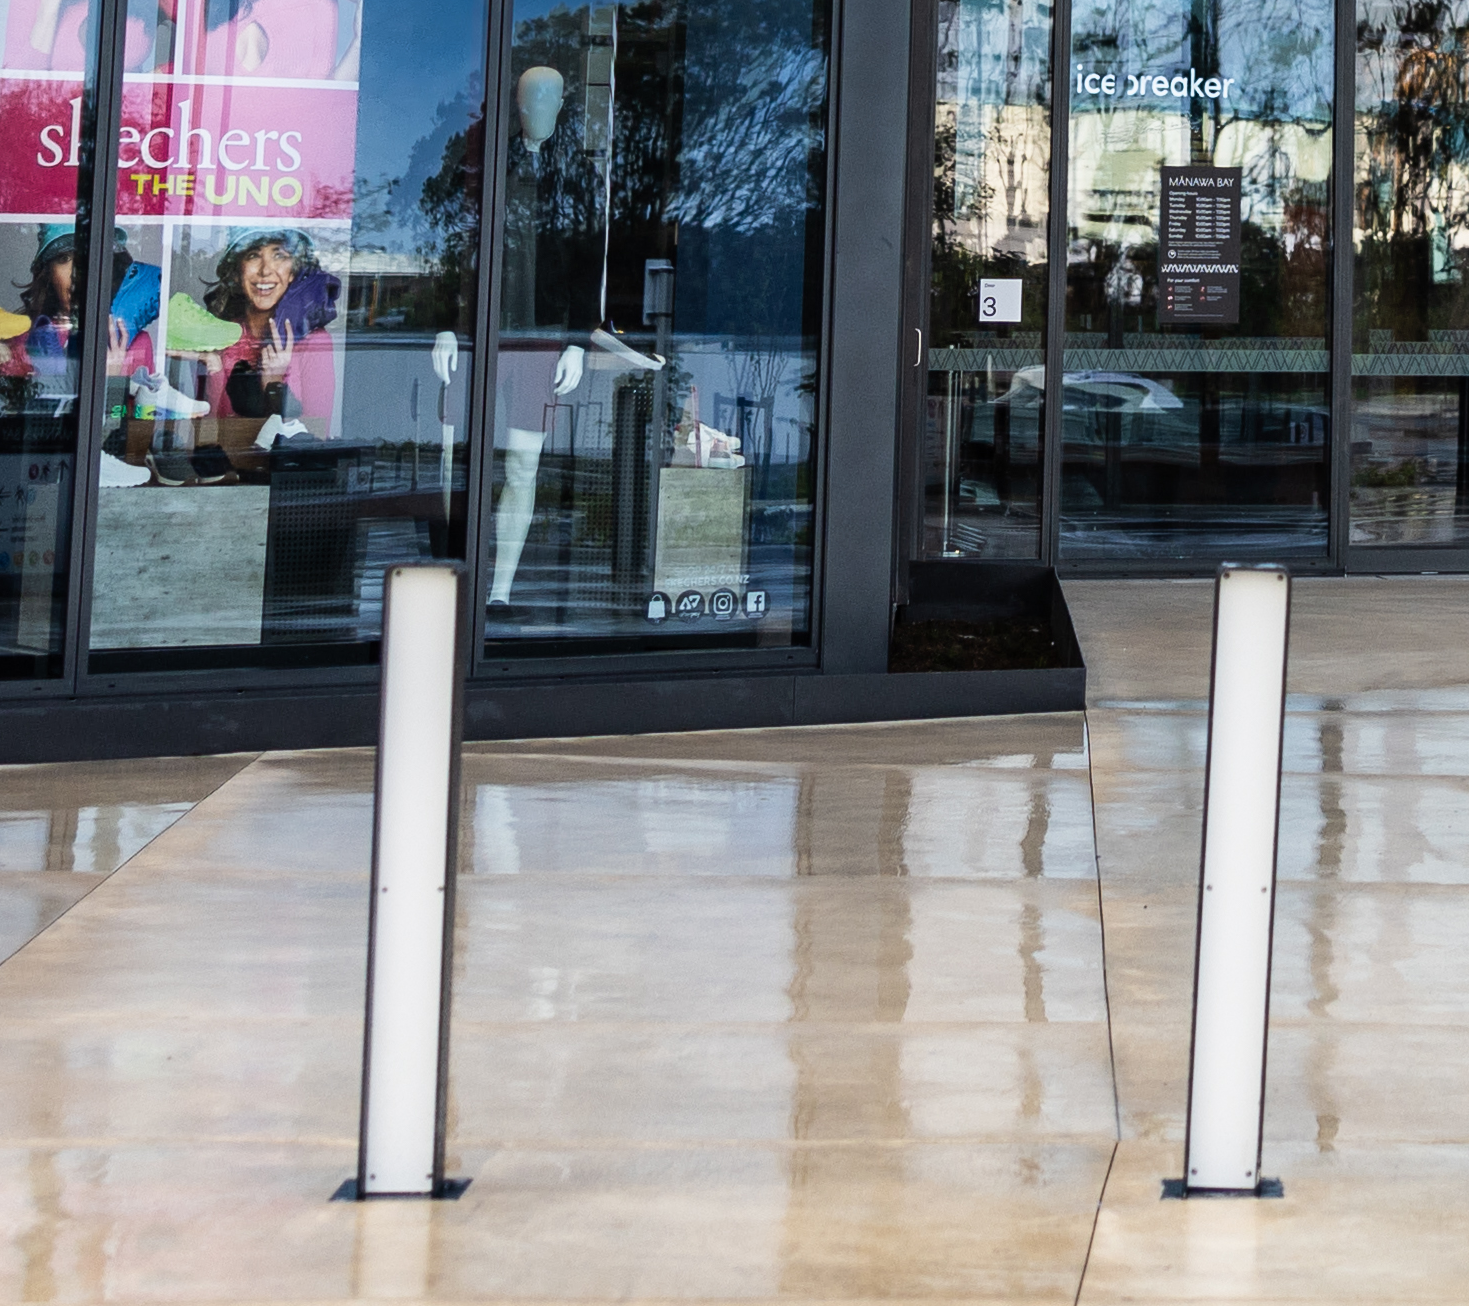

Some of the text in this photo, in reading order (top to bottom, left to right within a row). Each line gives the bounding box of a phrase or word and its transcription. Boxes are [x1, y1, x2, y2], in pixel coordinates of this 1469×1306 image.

[130, 174, 302, 207] THE UNO
[1216, 177, 1234, 187] BAY
[982, 296, 997, 317] 3
